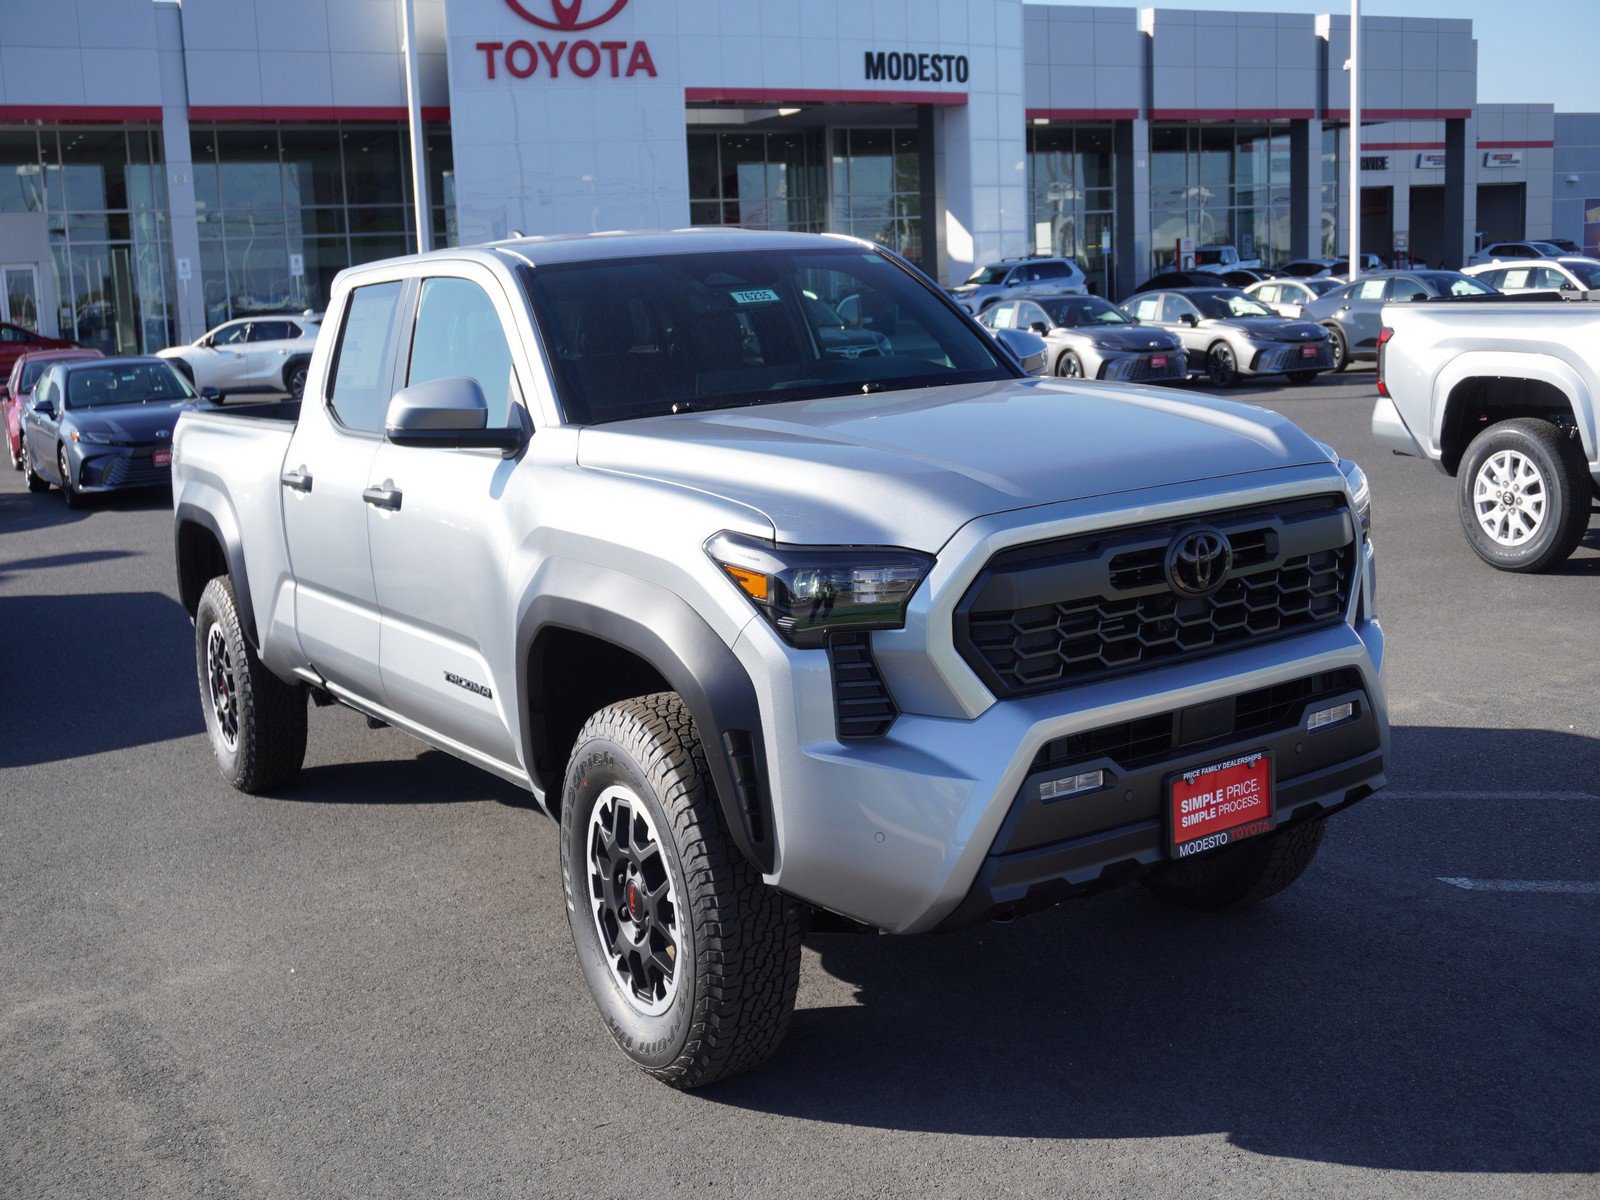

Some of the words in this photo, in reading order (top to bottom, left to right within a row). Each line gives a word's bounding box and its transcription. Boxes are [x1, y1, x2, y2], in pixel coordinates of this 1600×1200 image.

[476, 39, 658, 79] TOYOTA
[864, 51, 969, 83] MODESTO
[737, 291, 772, 301] 76235
[443, 670, 493, 700] TACOMA
[1183, 769, 1201, 780] PRICE
[1201, 764, 1222, 776] FAMILY
[1222, 753, 1262, 770] DEALERSHIPS
[1181, 789, 1224, 814] SIMPLE
[1226, 778, 1260, 800] PRICE.
[1181, 807, 1217, 828] SIMPLE
[1218, 794, 1261, 816] PROCESS.
[1179, 833, 1228, 858] MODESTO
[1231, 821, 1270, 841] TOYOTA
